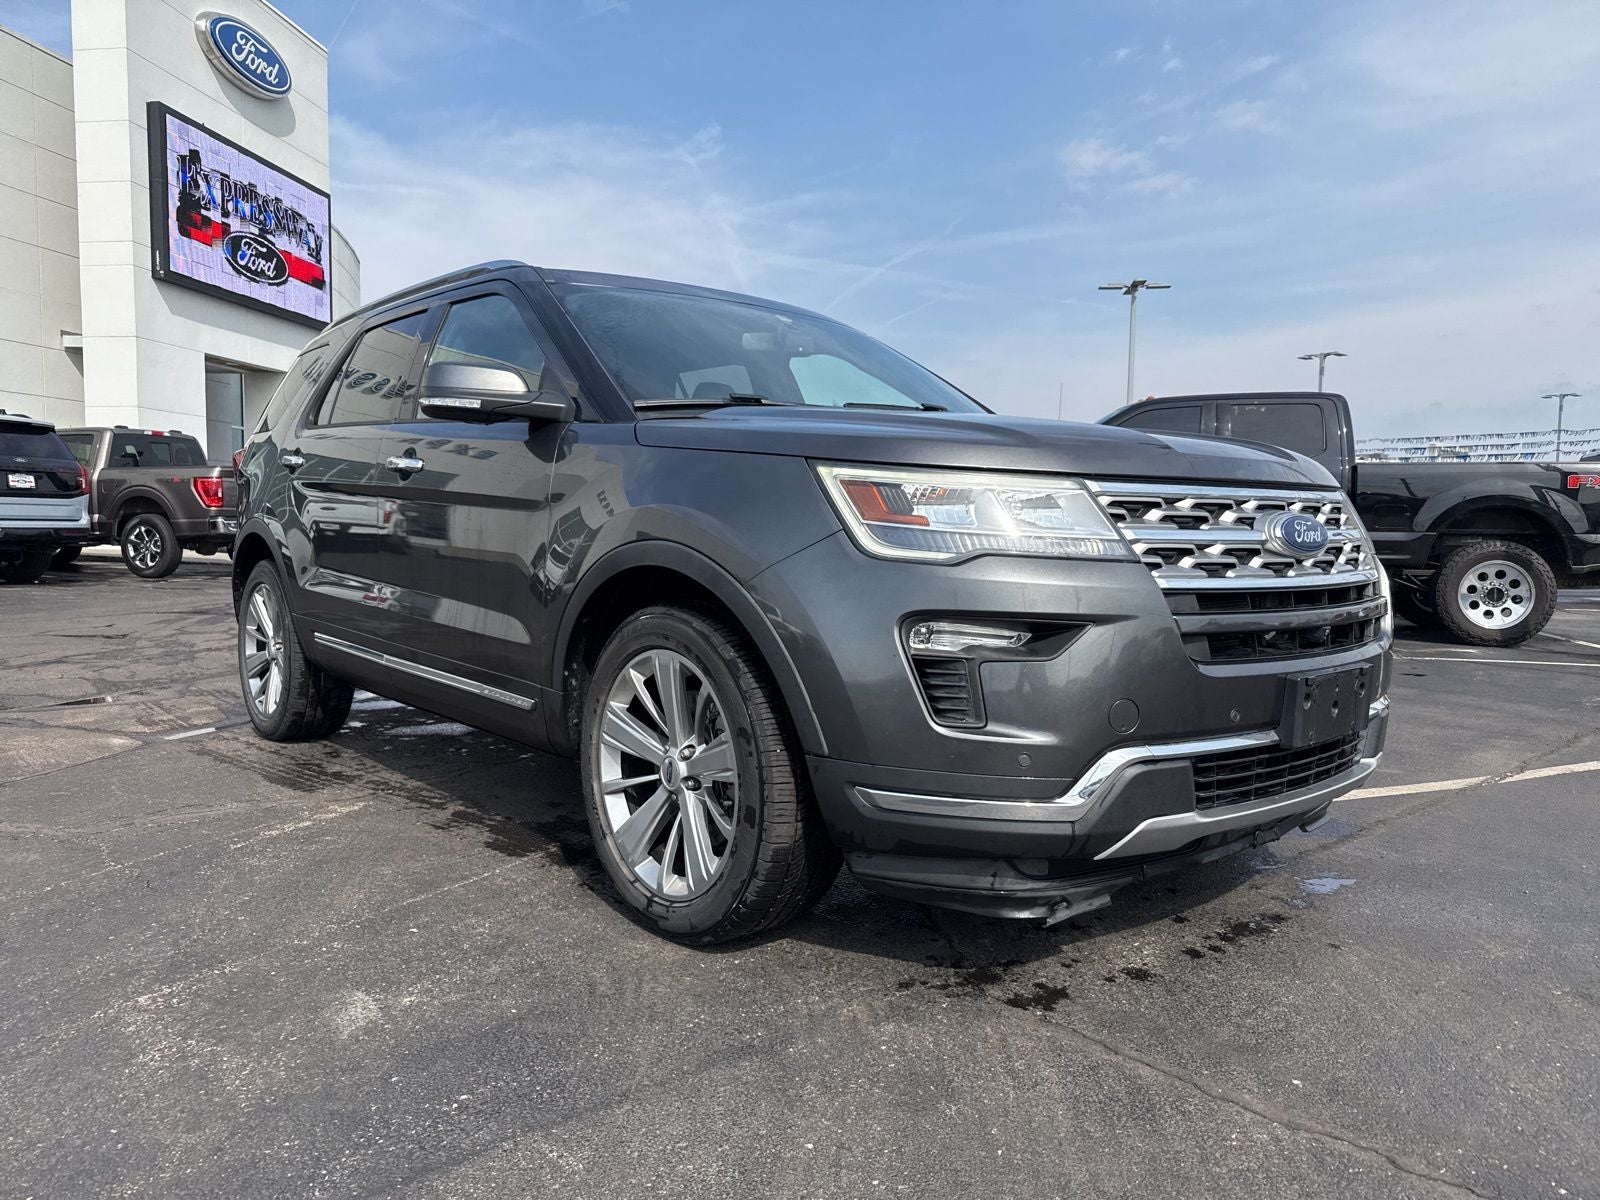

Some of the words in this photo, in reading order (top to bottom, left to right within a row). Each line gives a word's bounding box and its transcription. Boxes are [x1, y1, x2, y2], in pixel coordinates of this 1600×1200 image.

[231, 30, 280, 84] Ford
[237, 238, 277, 278] Ford
[1294, 520, 1323, 543] Ford
